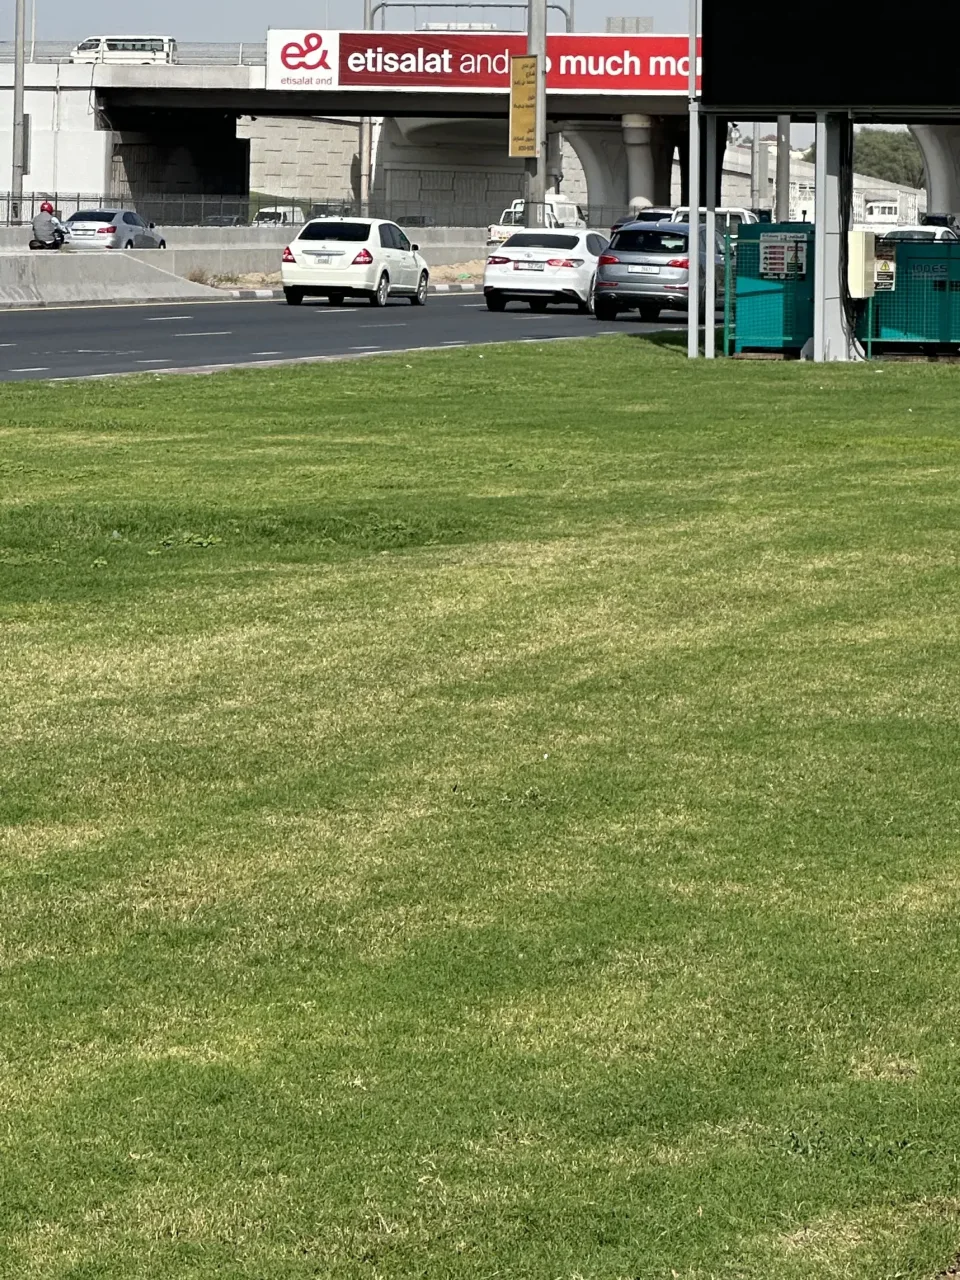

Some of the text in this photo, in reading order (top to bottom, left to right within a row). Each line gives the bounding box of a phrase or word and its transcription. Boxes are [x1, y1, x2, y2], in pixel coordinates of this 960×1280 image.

[347, 47, 453, 73] etisalat
[459, 49, 510, 74] and
[559, 50, 641, 76] much
[280, 76, 332, 85] etisalat and
